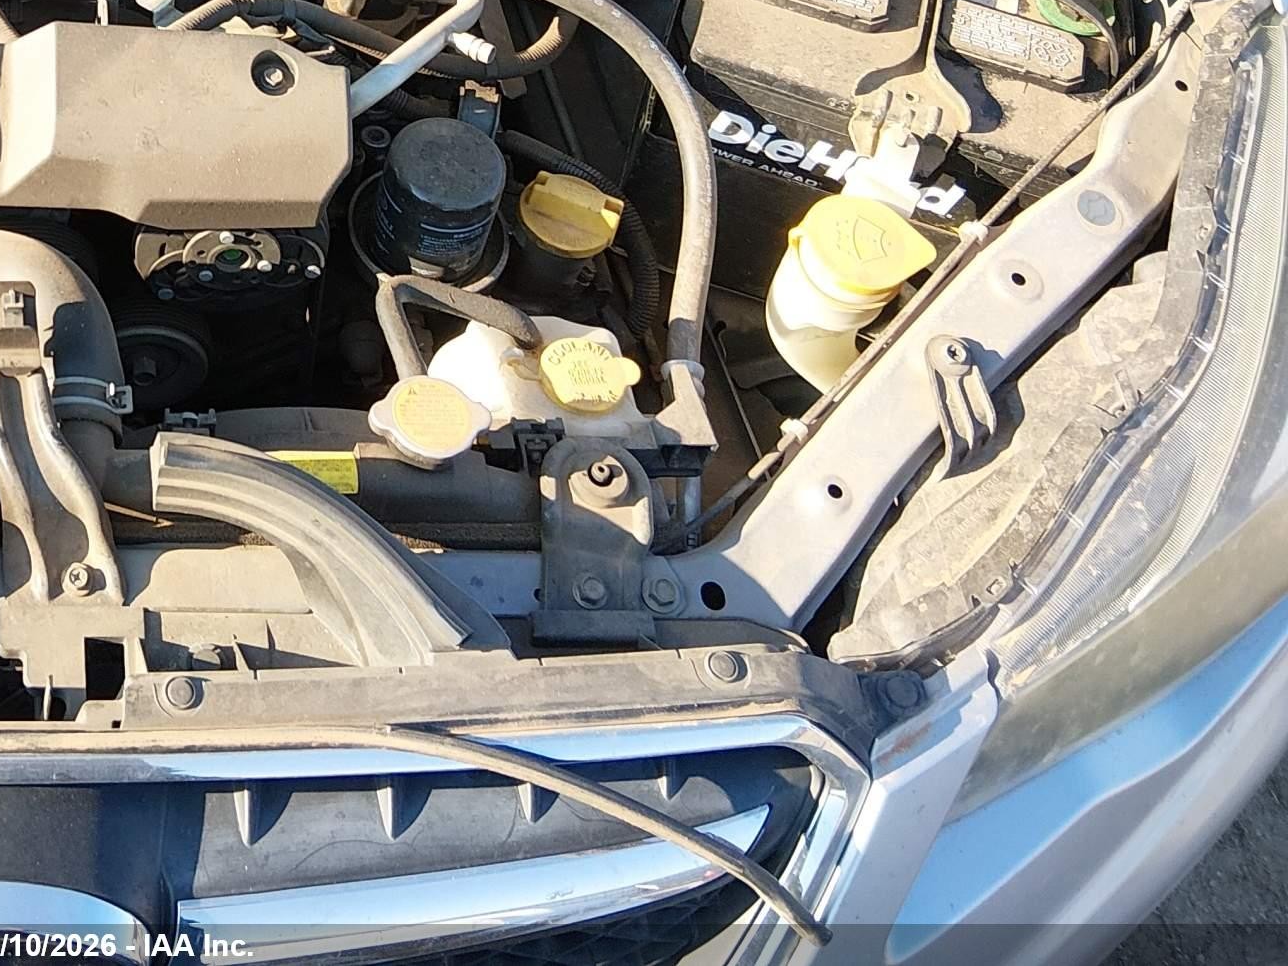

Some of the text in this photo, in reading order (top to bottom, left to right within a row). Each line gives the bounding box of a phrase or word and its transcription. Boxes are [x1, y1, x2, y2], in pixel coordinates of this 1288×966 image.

[708, 110, 967, 216] DieHd
[711, 146, 819, 187] OWER AHEAD
